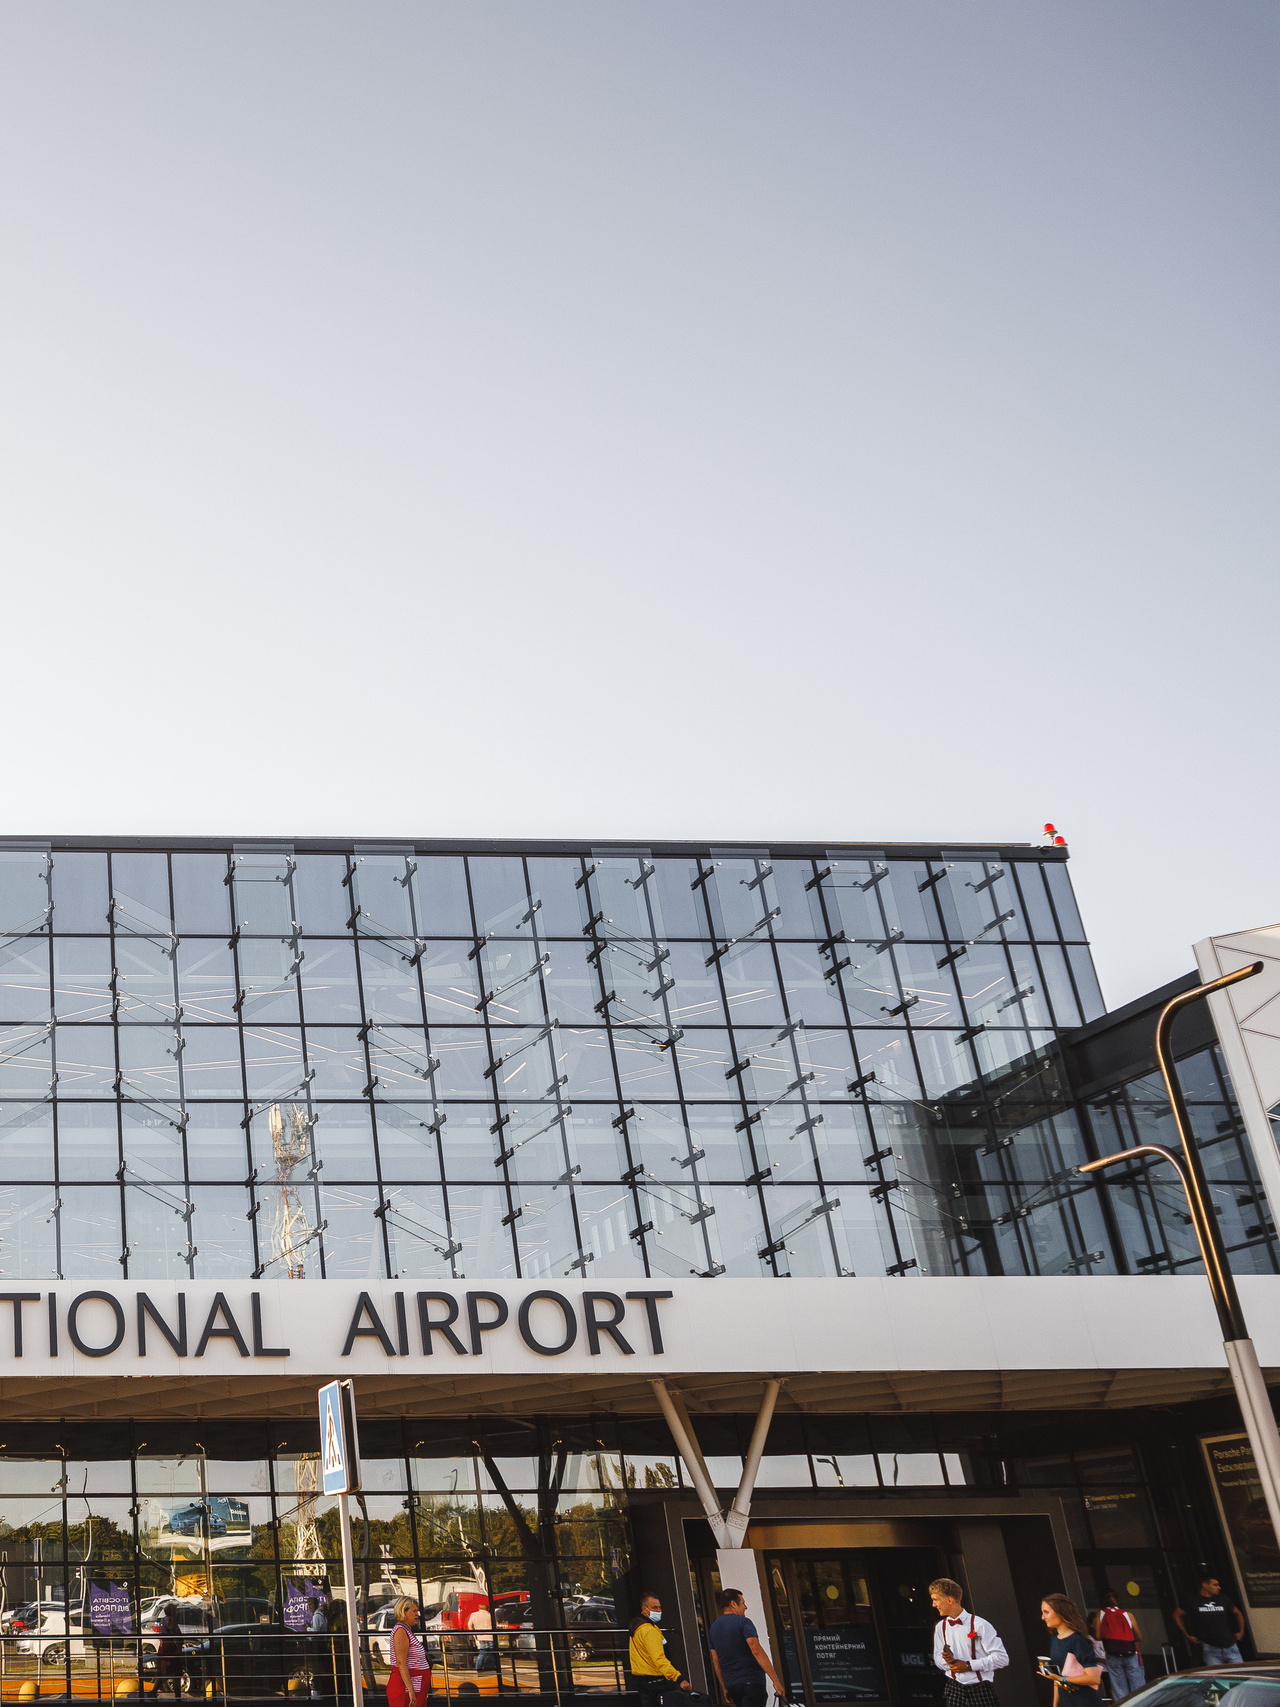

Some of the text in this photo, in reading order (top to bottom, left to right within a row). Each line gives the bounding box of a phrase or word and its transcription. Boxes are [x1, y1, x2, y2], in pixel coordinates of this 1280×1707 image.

[341, 1289, 674, 1357] AIRPORT
[1213, 1448, 1241, 1459] Porsche
[1198, 1605, 1225, 1613] HOLLISTER
[813, 1634, 841, 1642] ПРЯМИЙ
[814, 1642, 866, 1651] КОНТЕЙНЕРНИЙ
[901, 1654, 925, 1665] UGL
